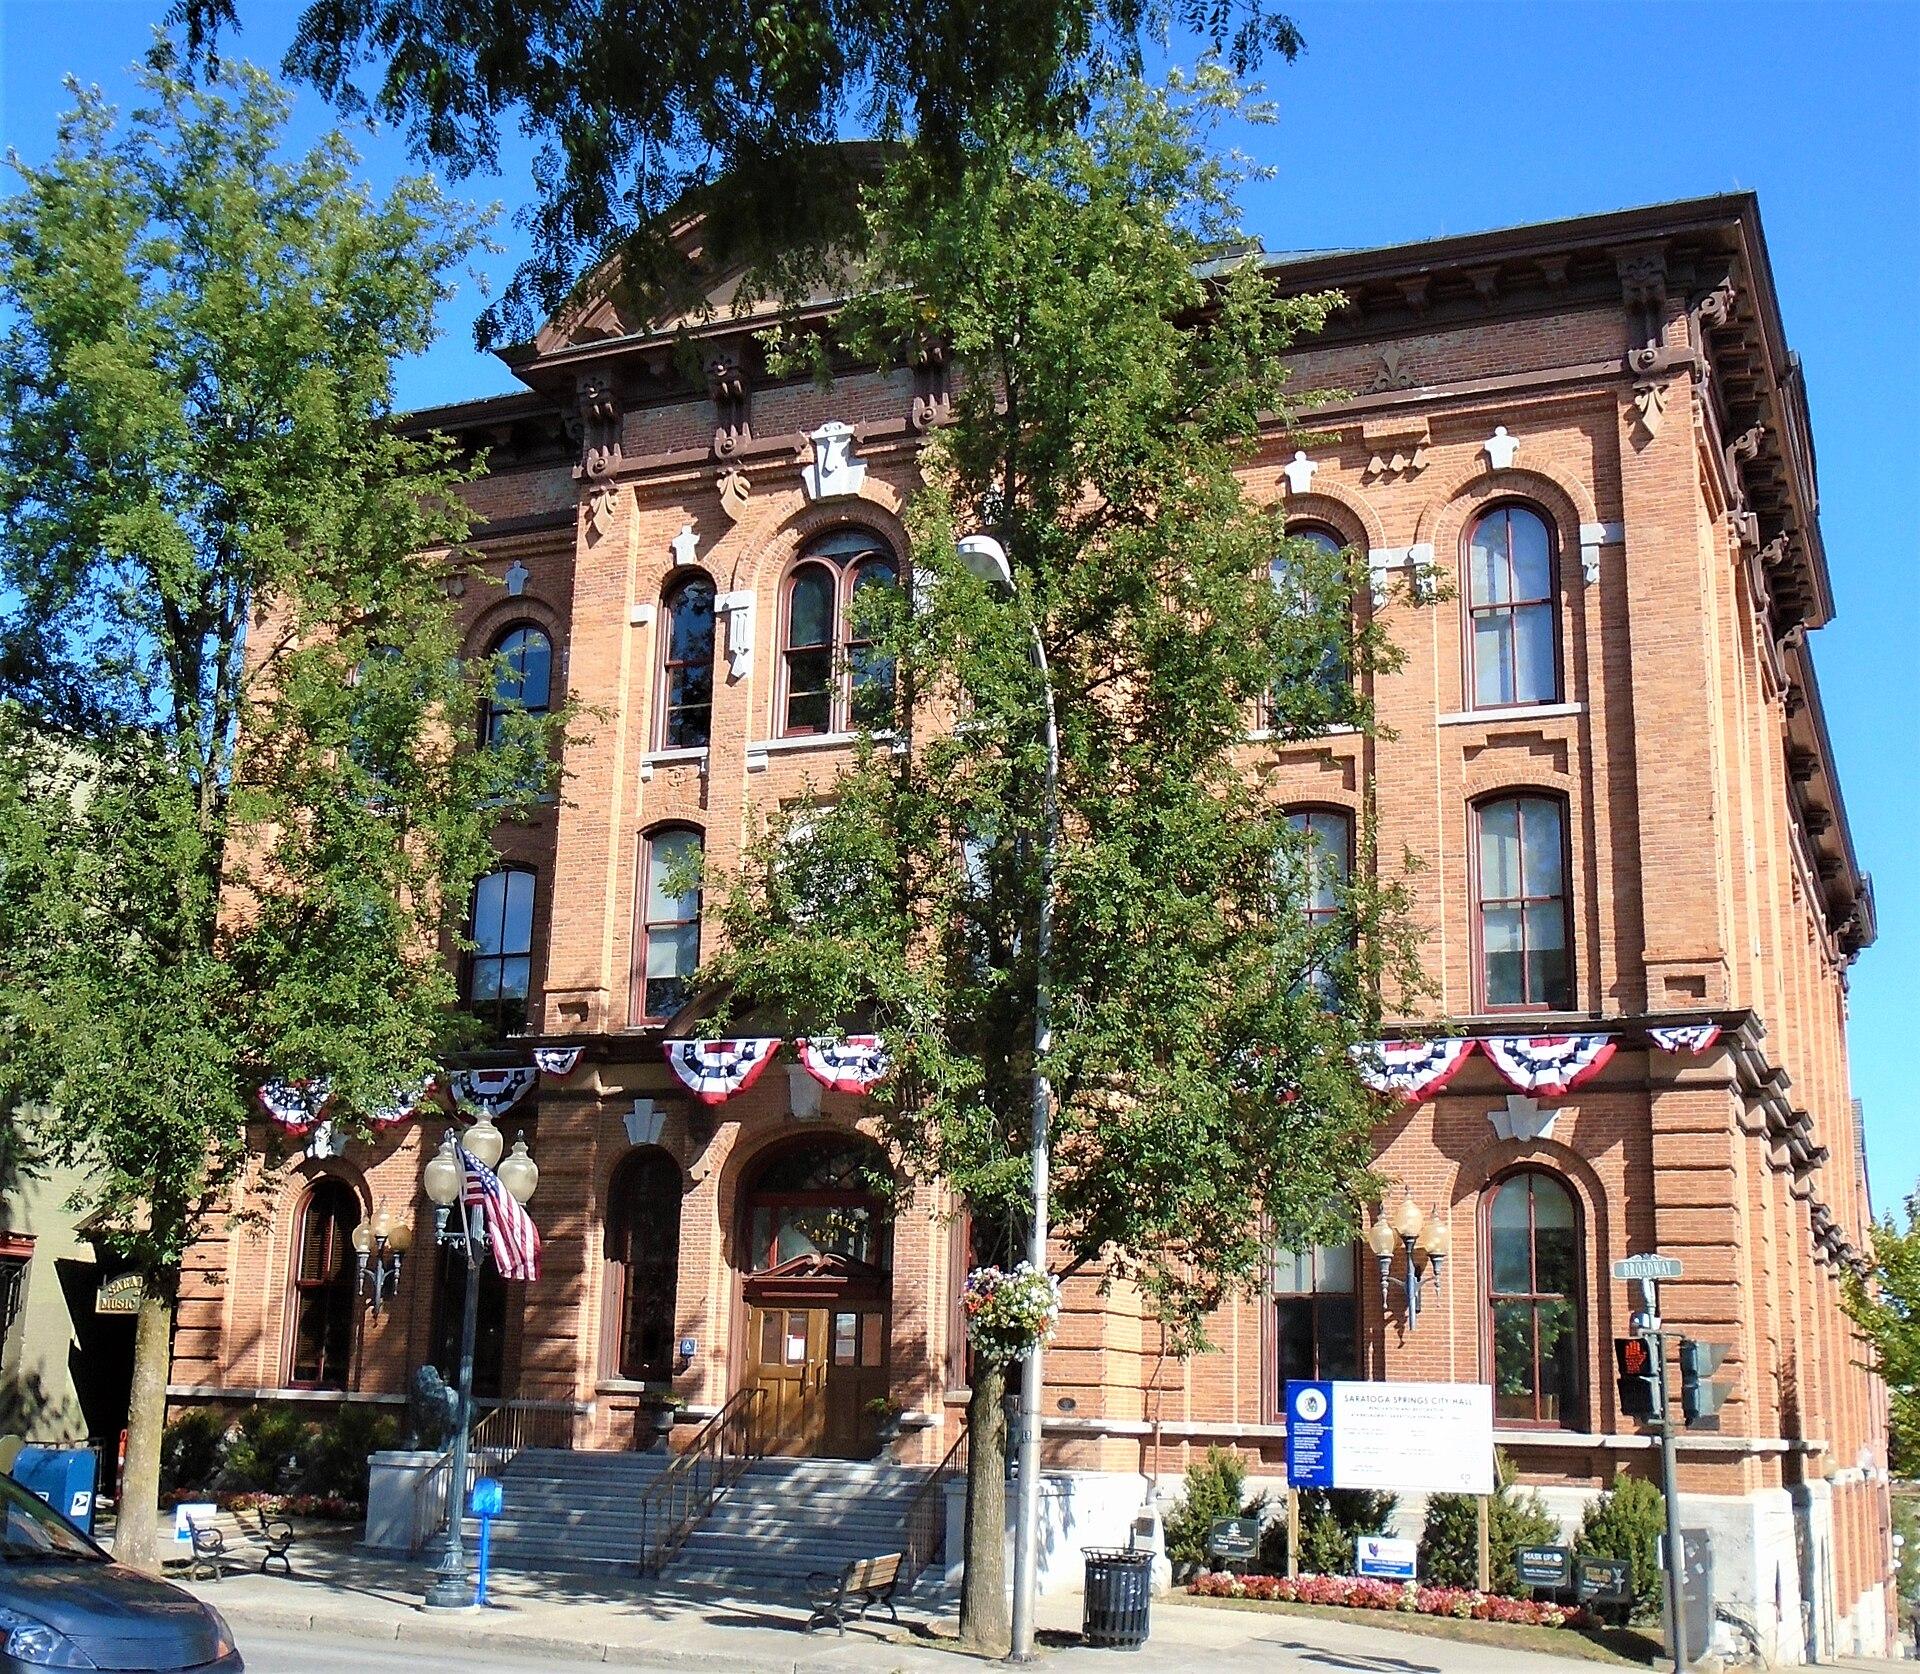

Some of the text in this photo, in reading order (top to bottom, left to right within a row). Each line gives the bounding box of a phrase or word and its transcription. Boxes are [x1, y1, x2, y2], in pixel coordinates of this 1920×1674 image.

[1623, 1261, 1672, 1277] BROADWAY
[101, 1298, 136, 1309] MUSIC
[1344, 1394, 1472, 1406] SARATOGA SPRINGS CITY HALL
[1523, 1552, 1542, 1560] MASK
